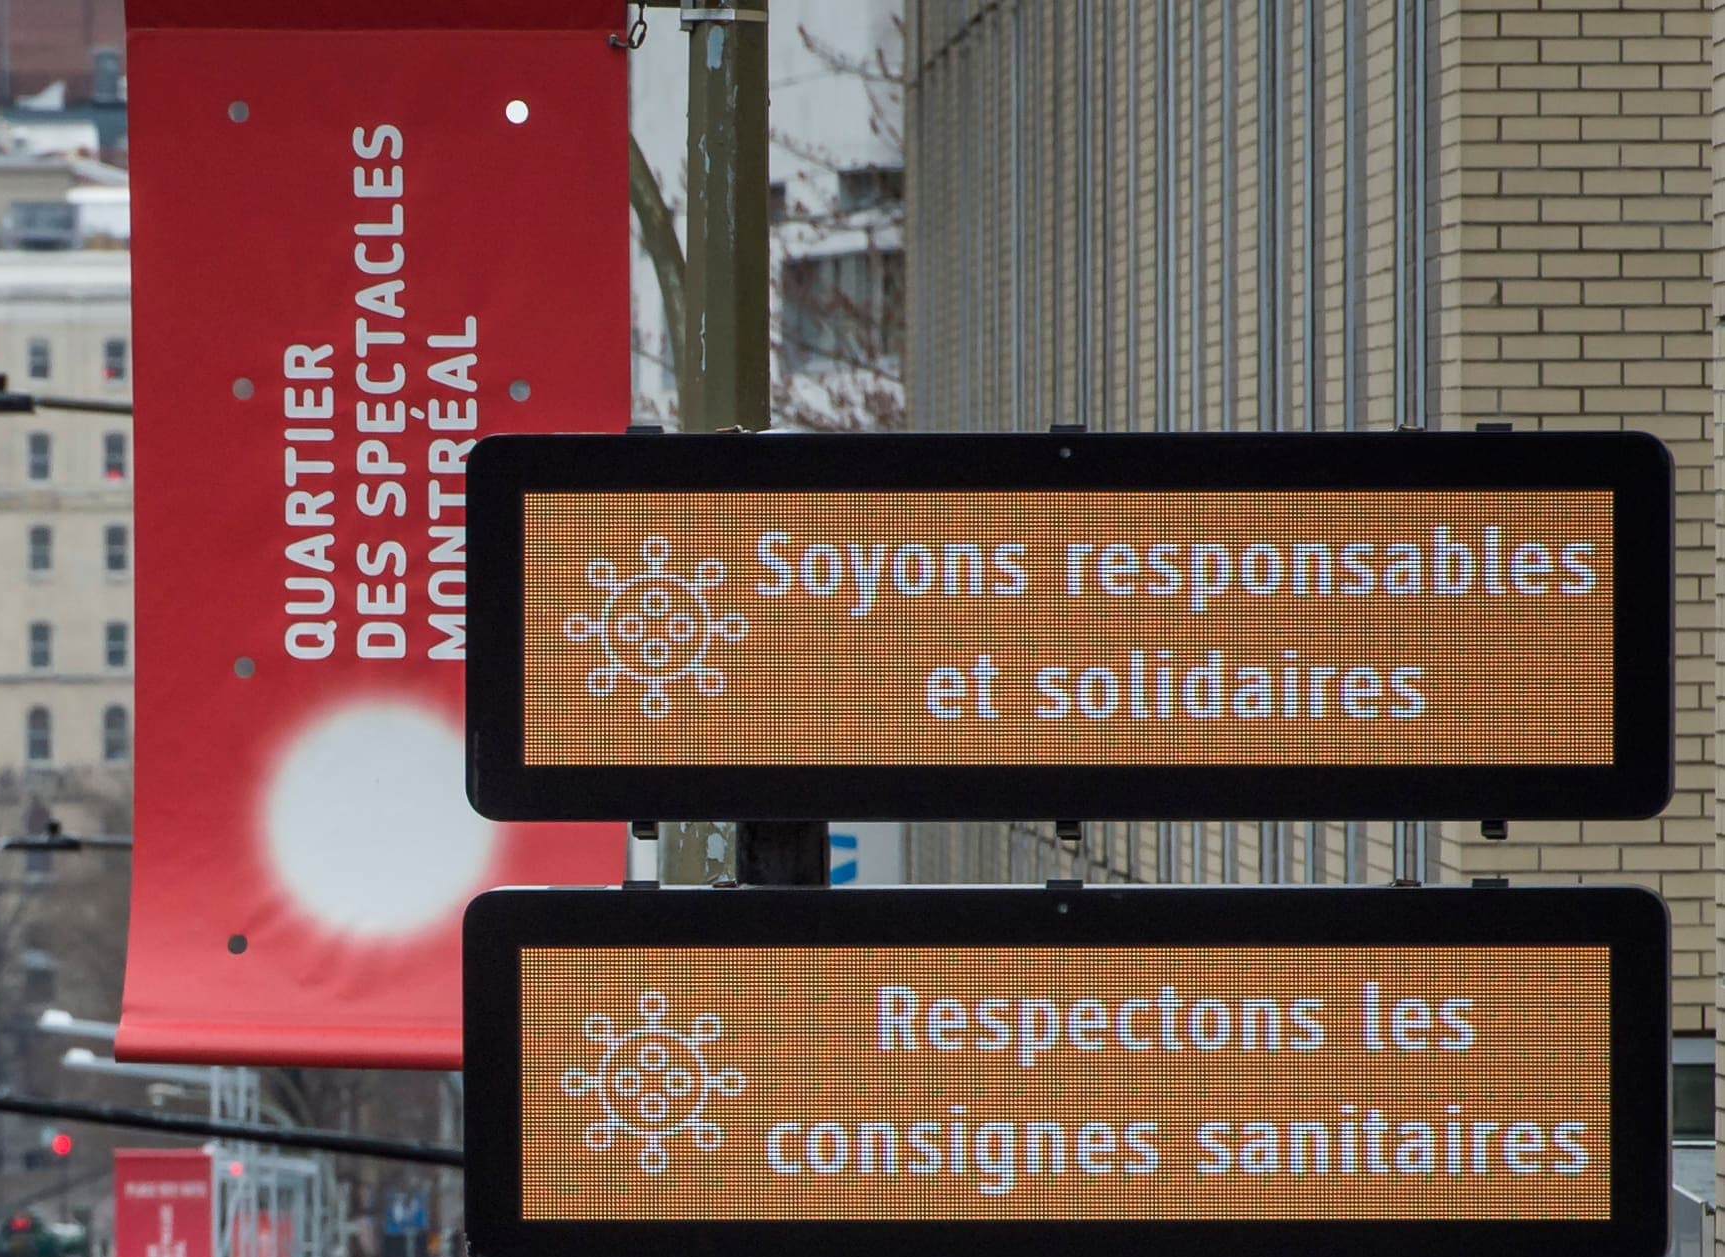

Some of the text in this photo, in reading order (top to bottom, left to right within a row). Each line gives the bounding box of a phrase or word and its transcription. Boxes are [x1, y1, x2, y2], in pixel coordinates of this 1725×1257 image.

[353, 125, 406, 658] DES SPECTACLES
[284, 345, 337, 659] QUARTIER
[410, 316, 477, 660] MONTRÉAL
[756, 526, 1597, 617] Soyons responsables
[926, 650, 1425, 720] et solidaires
[877, 981, 1475, 1067] Respectons les
[765, 1104, 1589, 1196] consignes sanitaires
